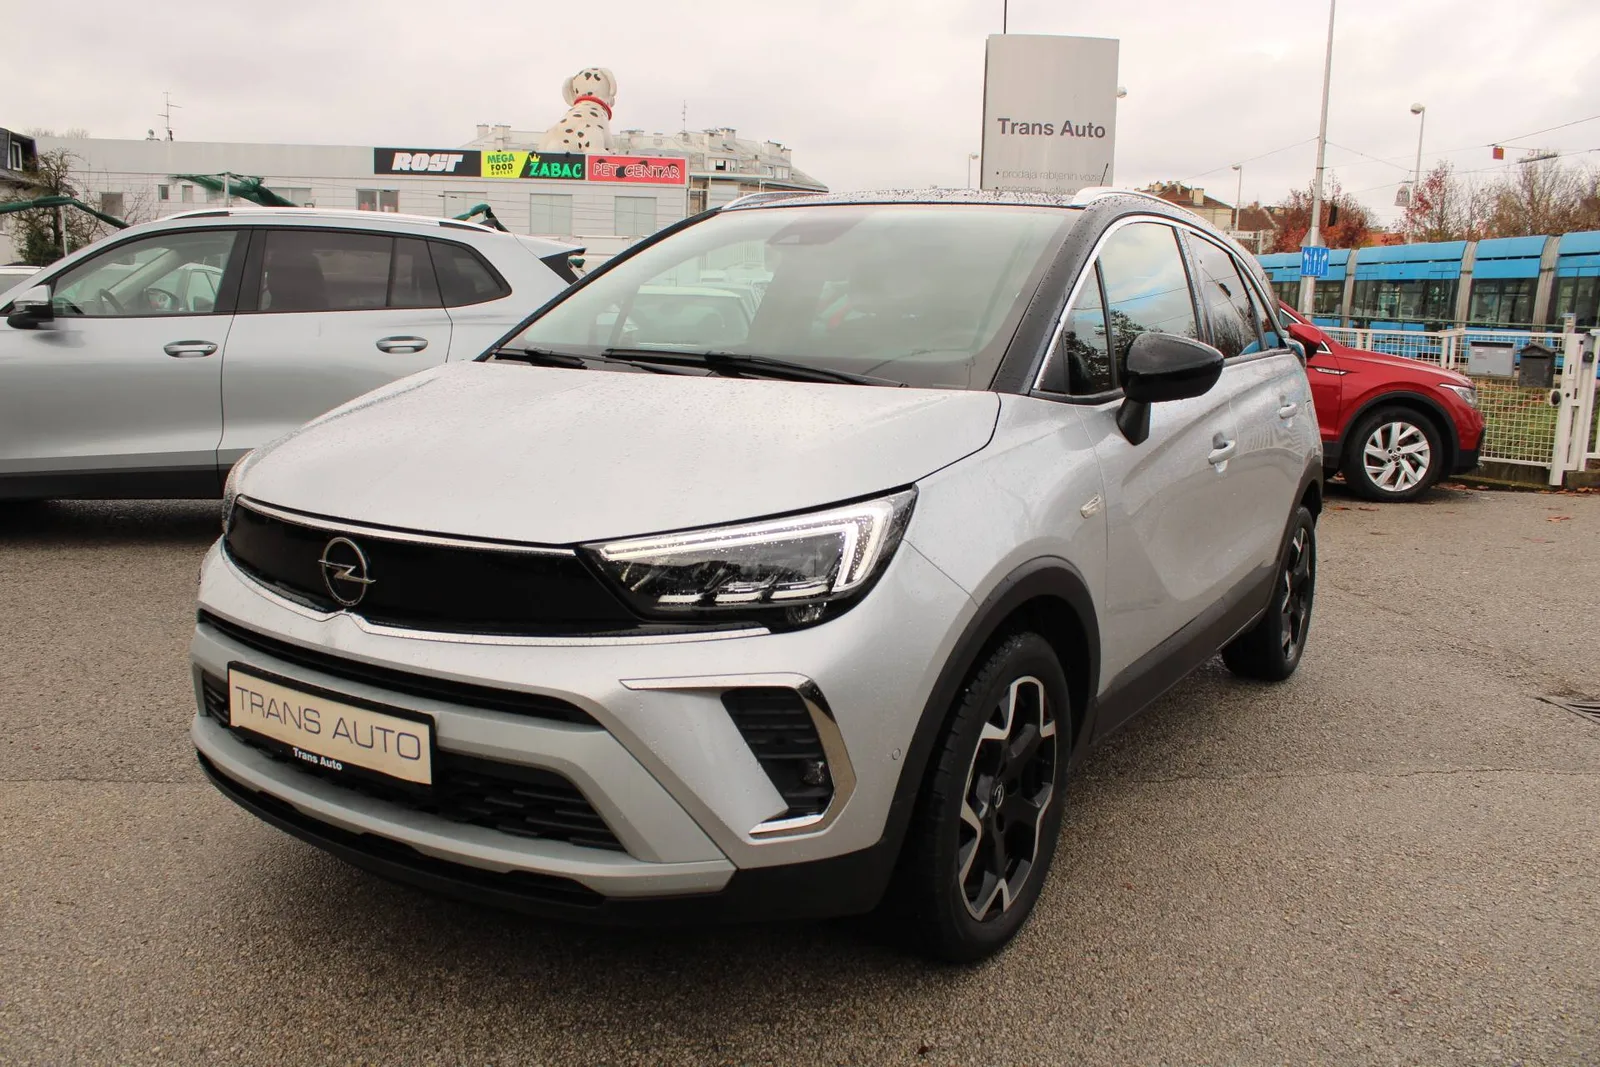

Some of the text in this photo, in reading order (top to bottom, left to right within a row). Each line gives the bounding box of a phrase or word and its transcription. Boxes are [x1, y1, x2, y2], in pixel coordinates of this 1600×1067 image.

[997, 118, 1106, 138] Trans Auto
[391, 152, 464, 173] ROST
[487, 154, 515, 164] MEGA
[490, 163, 514, 171] FOOD
[593, 162, 680, 179] PET CENTAR
[1002, 169, 1038, 181] prodaja
[235, 686, 421, 761] TRANS AUTO
[293, 747, 343, 771] Trans Auto
